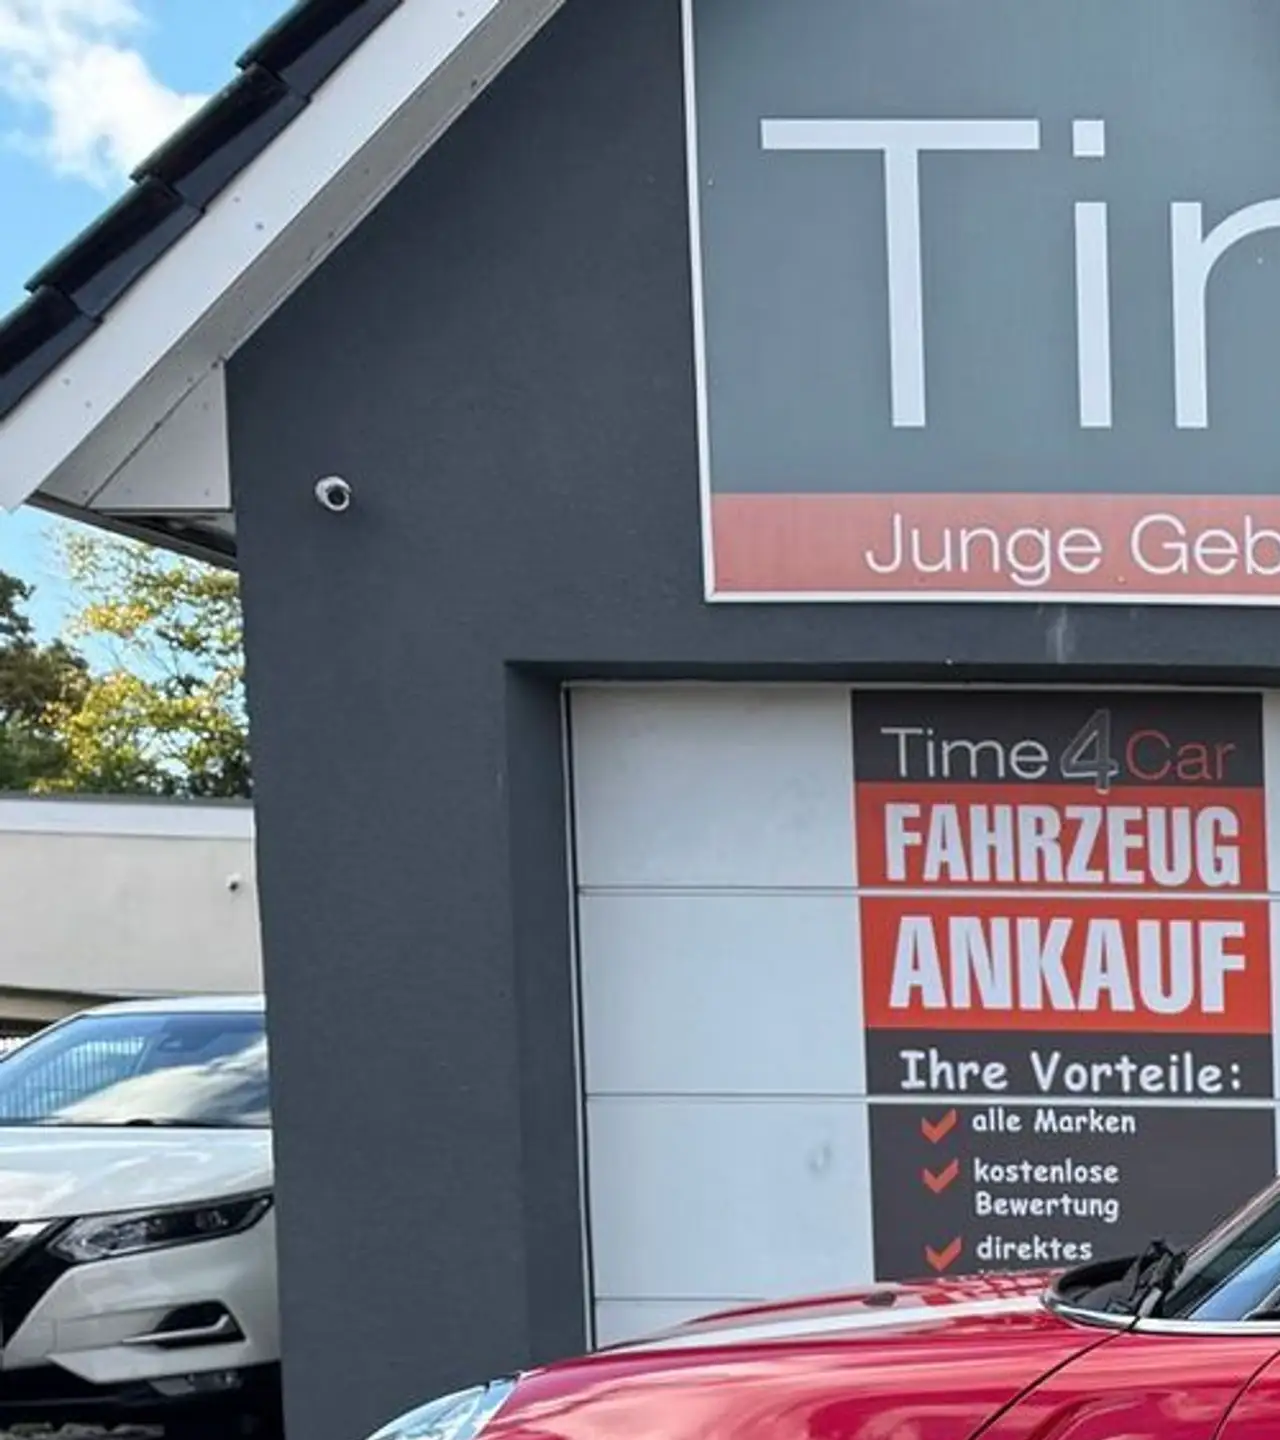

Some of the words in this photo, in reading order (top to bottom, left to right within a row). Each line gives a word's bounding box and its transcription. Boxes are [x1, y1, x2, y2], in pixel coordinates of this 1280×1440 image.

[865, 512, 1103, 587] Junge
[885, 803, 1240, 886] FAHRZEUG
[888, 914, 1246, 1015] ANKAUF
[900, 1049, 1008, 1093] Ihre
[1031, 1050, 1243, 1095] Vorteile:
[972, 1108, 1021, 1133] alle
[1034, 1108, 1136, 1134] Marken
[973, 1158, 1120, 1185] kostenlose
[974, 1191, 1121, 1222] Bewertung
[975, 1233, 1093, 1261] direktes
